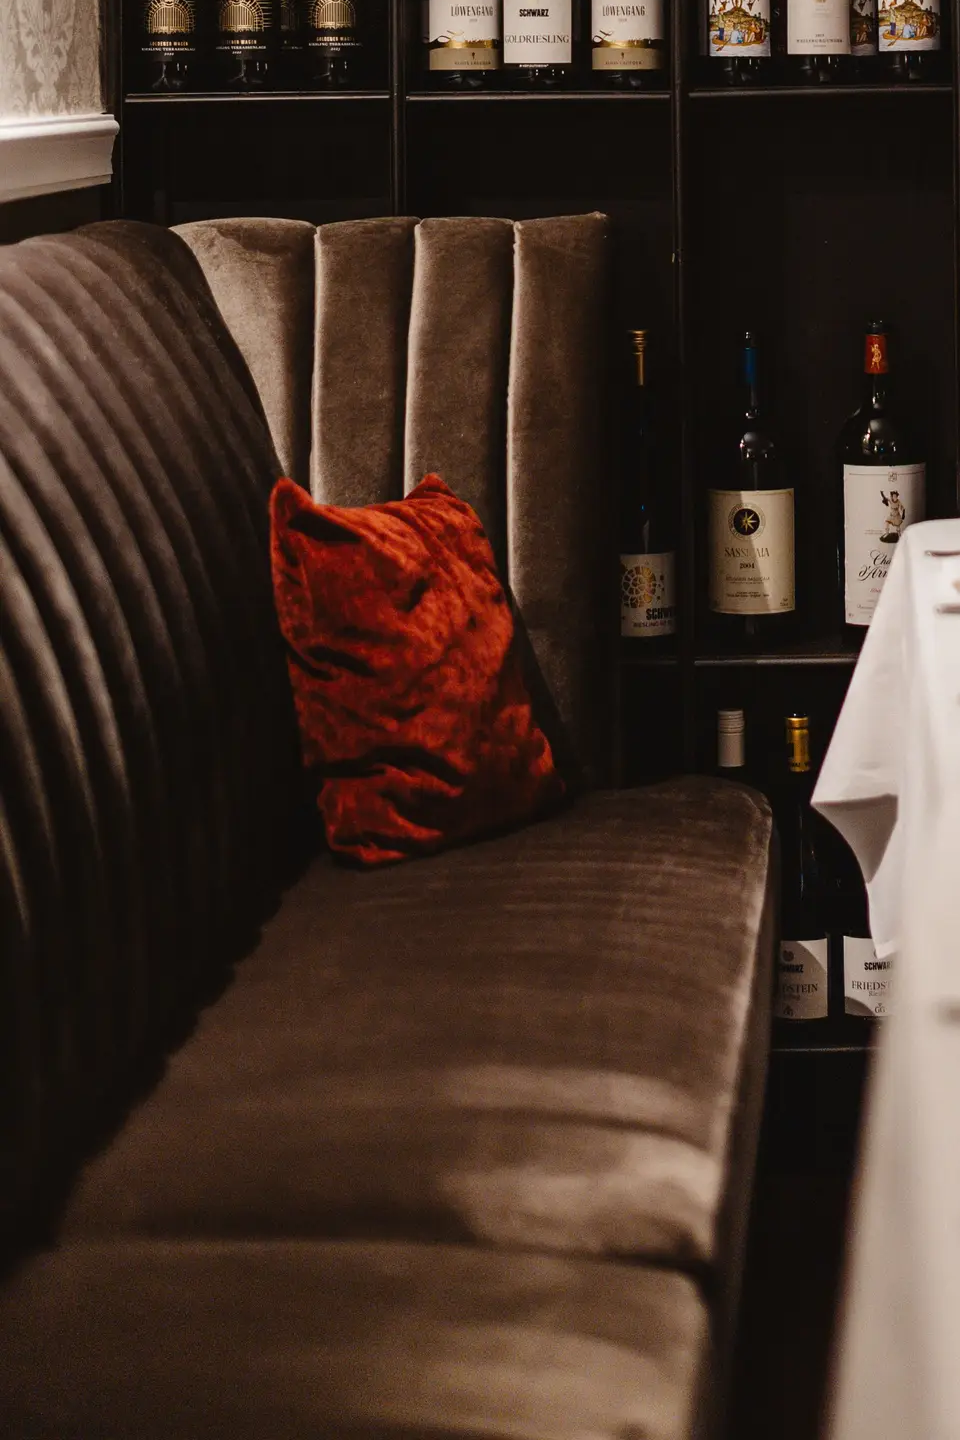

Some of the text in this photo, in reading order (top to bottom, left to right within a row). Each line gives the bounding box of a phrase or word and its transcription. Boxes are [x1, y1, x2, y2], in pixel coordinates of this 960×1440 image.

[450, 3, 494, 18] LÖWENGANG
[519, 8, 550, 18] SCHWARZ
[602, 3, 646, 18] LÖWENGANG
[504, 34, 570, 45] GOLDRIESLING
